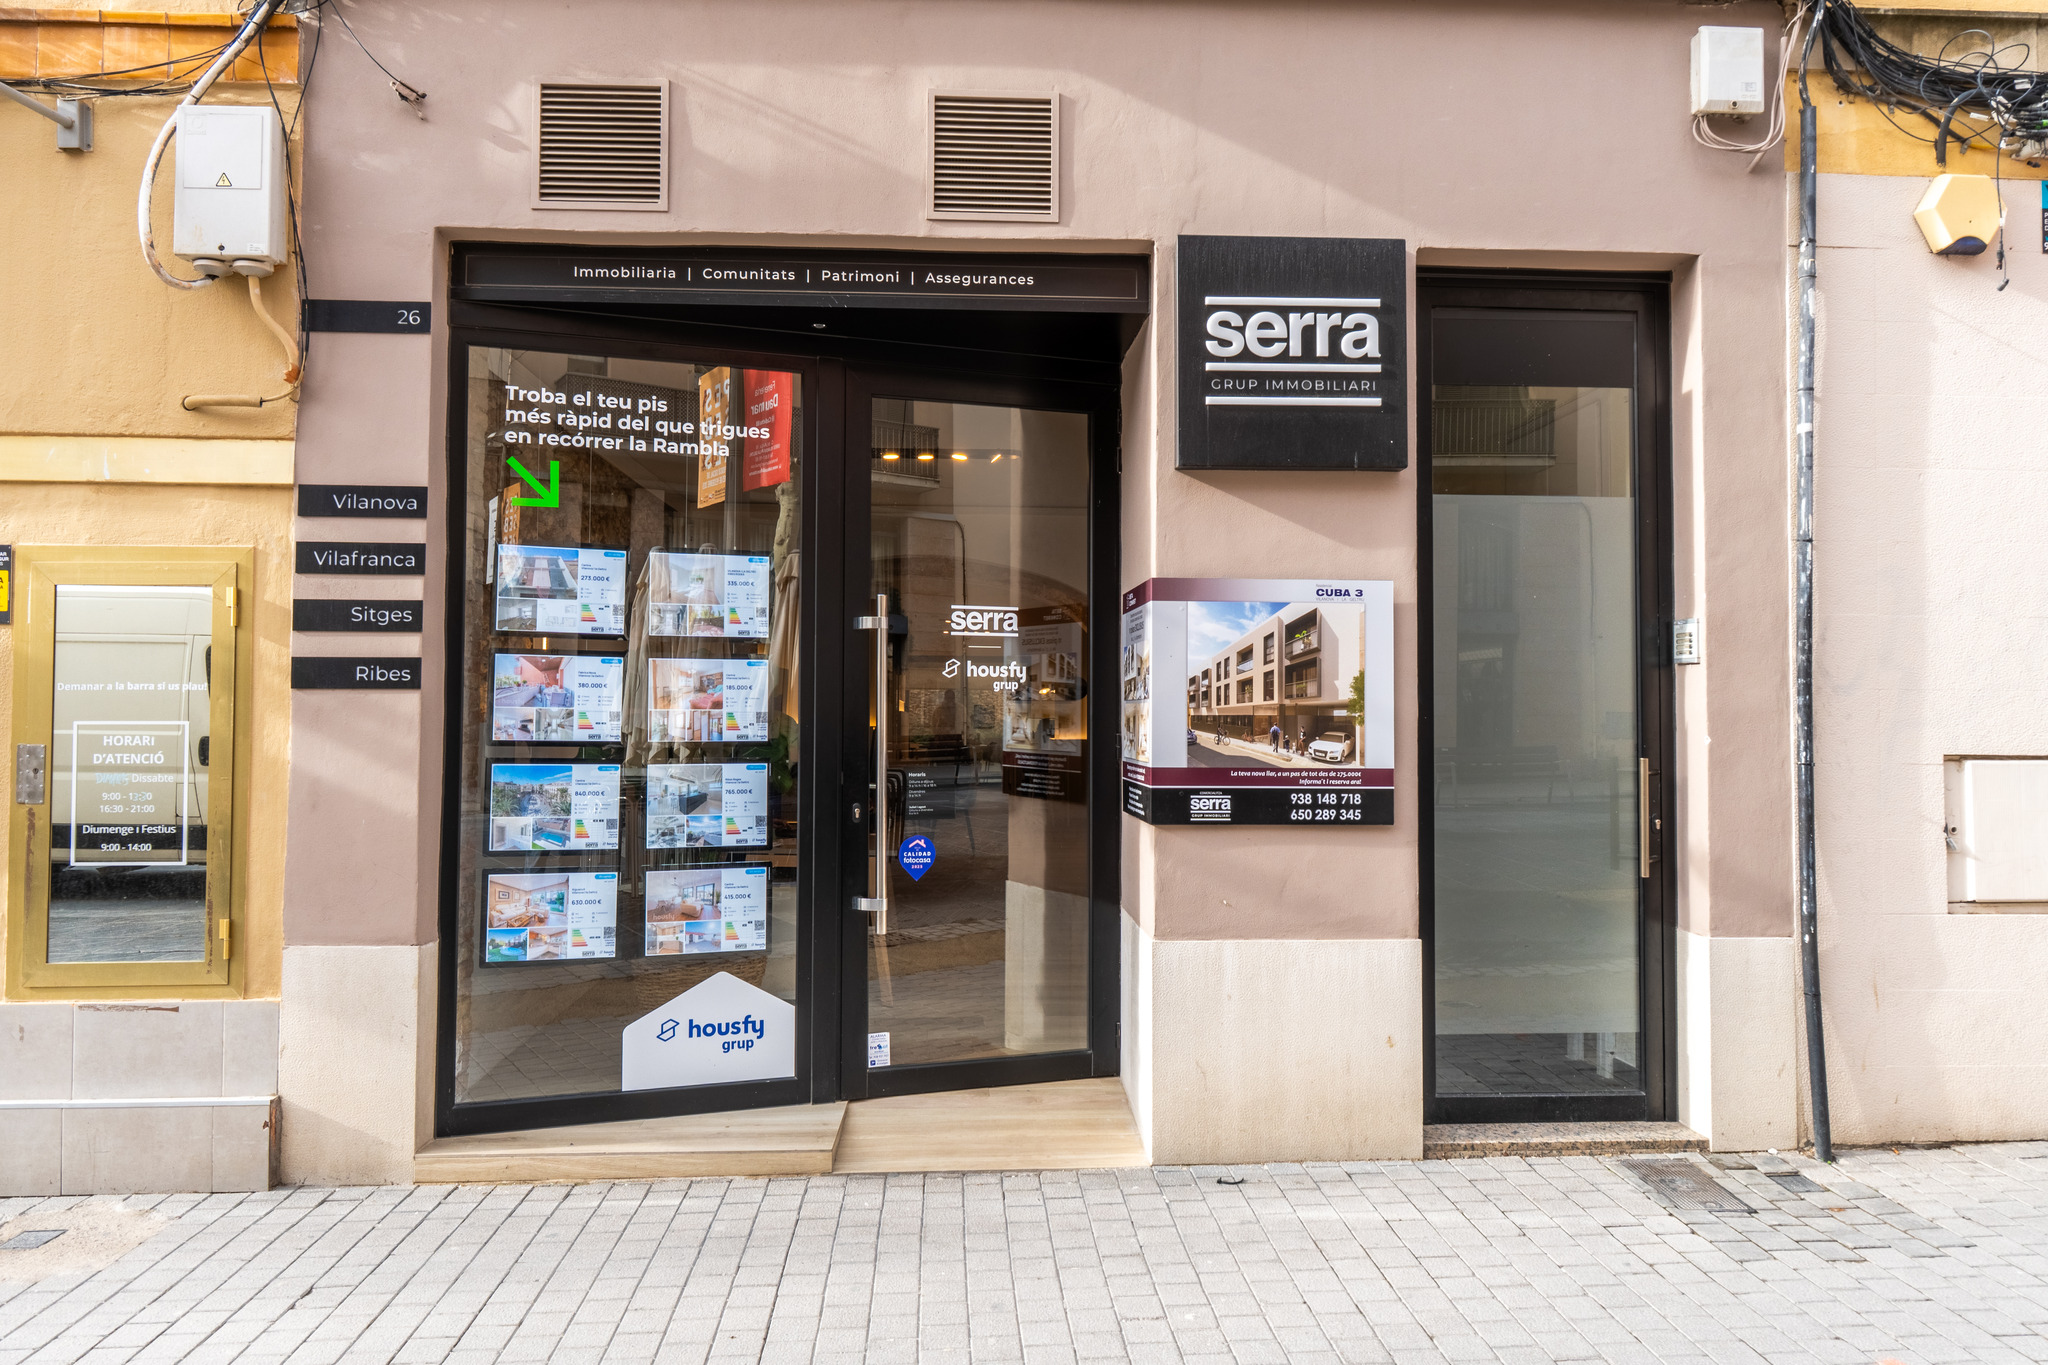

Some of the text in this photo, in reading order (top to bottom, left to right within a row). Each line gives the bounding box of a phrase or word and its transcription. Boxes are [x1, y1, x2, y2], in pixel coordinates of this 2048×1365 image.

[573, 266, 676, 279] Immobiliaria
[702, 268, 796, 280] Comunitats
[821, 270, 900, 283] Patrimoni
[925, 272, 1034, 287] Assegurances
[397, 309, 421, 325] 26
[1205, 310, 1382, 358] serra
[1211, 379, 1377, 391] GRUP IMMOBILIARI
[505, 385, 668, 414] Troba el teu pis
[505, 408, 552, 424] més
[557, 410, 612, 430] ràpid
[617, 414, 650, 431] del
[655, 420, 695, 436] que
[699, 420, 770, 440] trigues
[504, 430, 730, 457] en recórrer la Rambla
[332, 493, 418, 511] Vilanova
[314, 550, 416, 568] Vilafranca
[1316, 588, 1364, 597] CUBA 3
[350, 606, 413, 625] Sitges
[950, 610, 1018, 631] serra
[355, 665, 411, 682] Ribes
[966, 660, 1027, 683] housfy
[57, 682, 104, 691] Demanar
[115, 682, 124, 690] la
[127, 681, 155, 690] barra
[182, 682, 208, 693] plau!
[992, 680, 1019, 693] grup
[103, 735, 155, 746] HORARI
[93, 751, 165, 764] D'ATENCIÓ
[131, 773, 174, 783] Dissabte
[102, 792, 121, 801] 9:00
[1290, 793, 1361, 805] 938 148 718
[100, 805, 123, 813] 16:30
[130, 805, 155, 813] 21:00
[1190, 798, 1231, 810] serra
[1290, 809, 1361, 820] 650 289 345
[82, 824, 134, 836] Diumenge
[141, 824, 176, 834] Festius
[101, 843, 121, 852] 9:00
[128, 843, 152, 852] 14:00
[688, 1014, 765, 1040] housfy
[721, 1039, 755, 1053] grup
